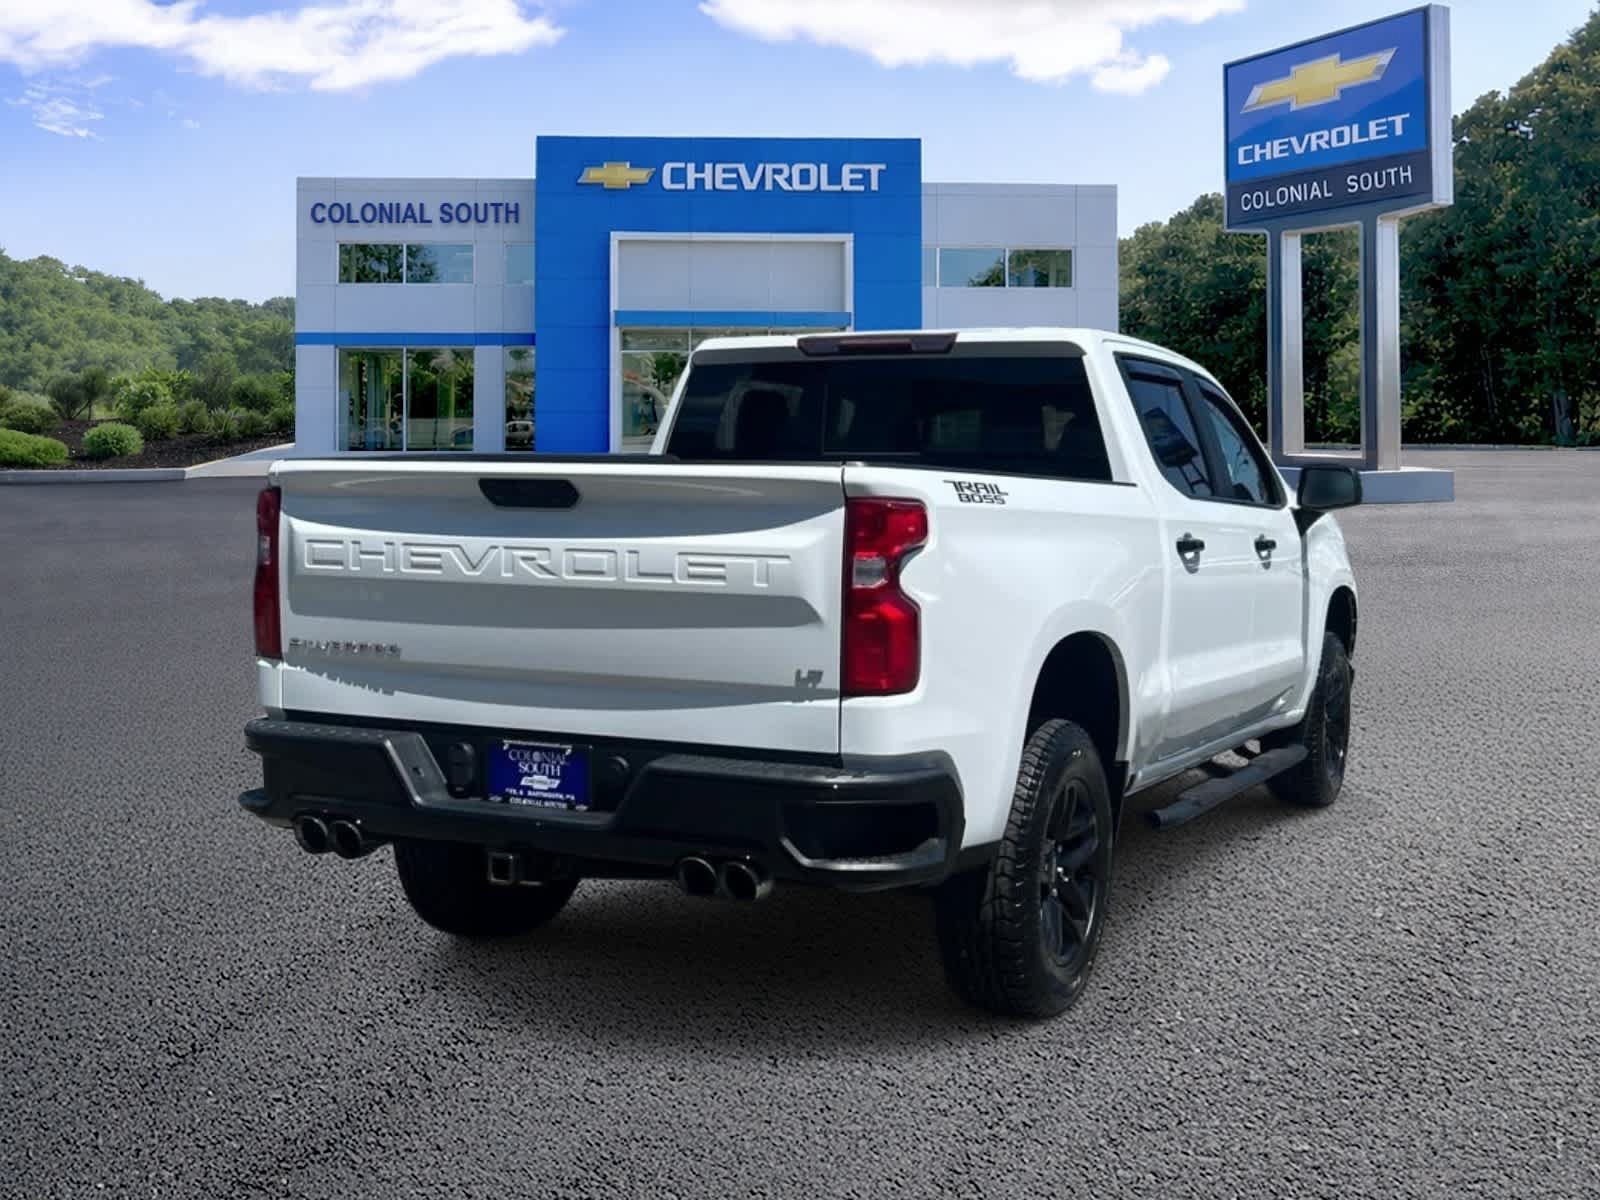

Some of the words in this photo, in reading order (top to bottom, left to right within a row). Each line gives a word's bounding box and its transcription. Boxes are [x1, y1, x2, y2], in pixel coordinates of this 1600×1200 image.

[1237, 113, 1410, 165] CHEVROLET
[662, 162, 886, 192] CHEVROLET
[1240, 179, 1333, 212] COLONIAL
[1346, 164, 1413, 194] SOUTH
[310, 202, 433, 224] COLONIAL
[439, 202, 520, 224] SOUTH
[942, 479, 1008, 496] TRAIL
[958, 493, 1006, 505] BOSS
[303, 538, 791, 588] CHEVROLET
[508, 749, 570, 765] COLONIAL
[518, 761, 561, 777] SOUTH
